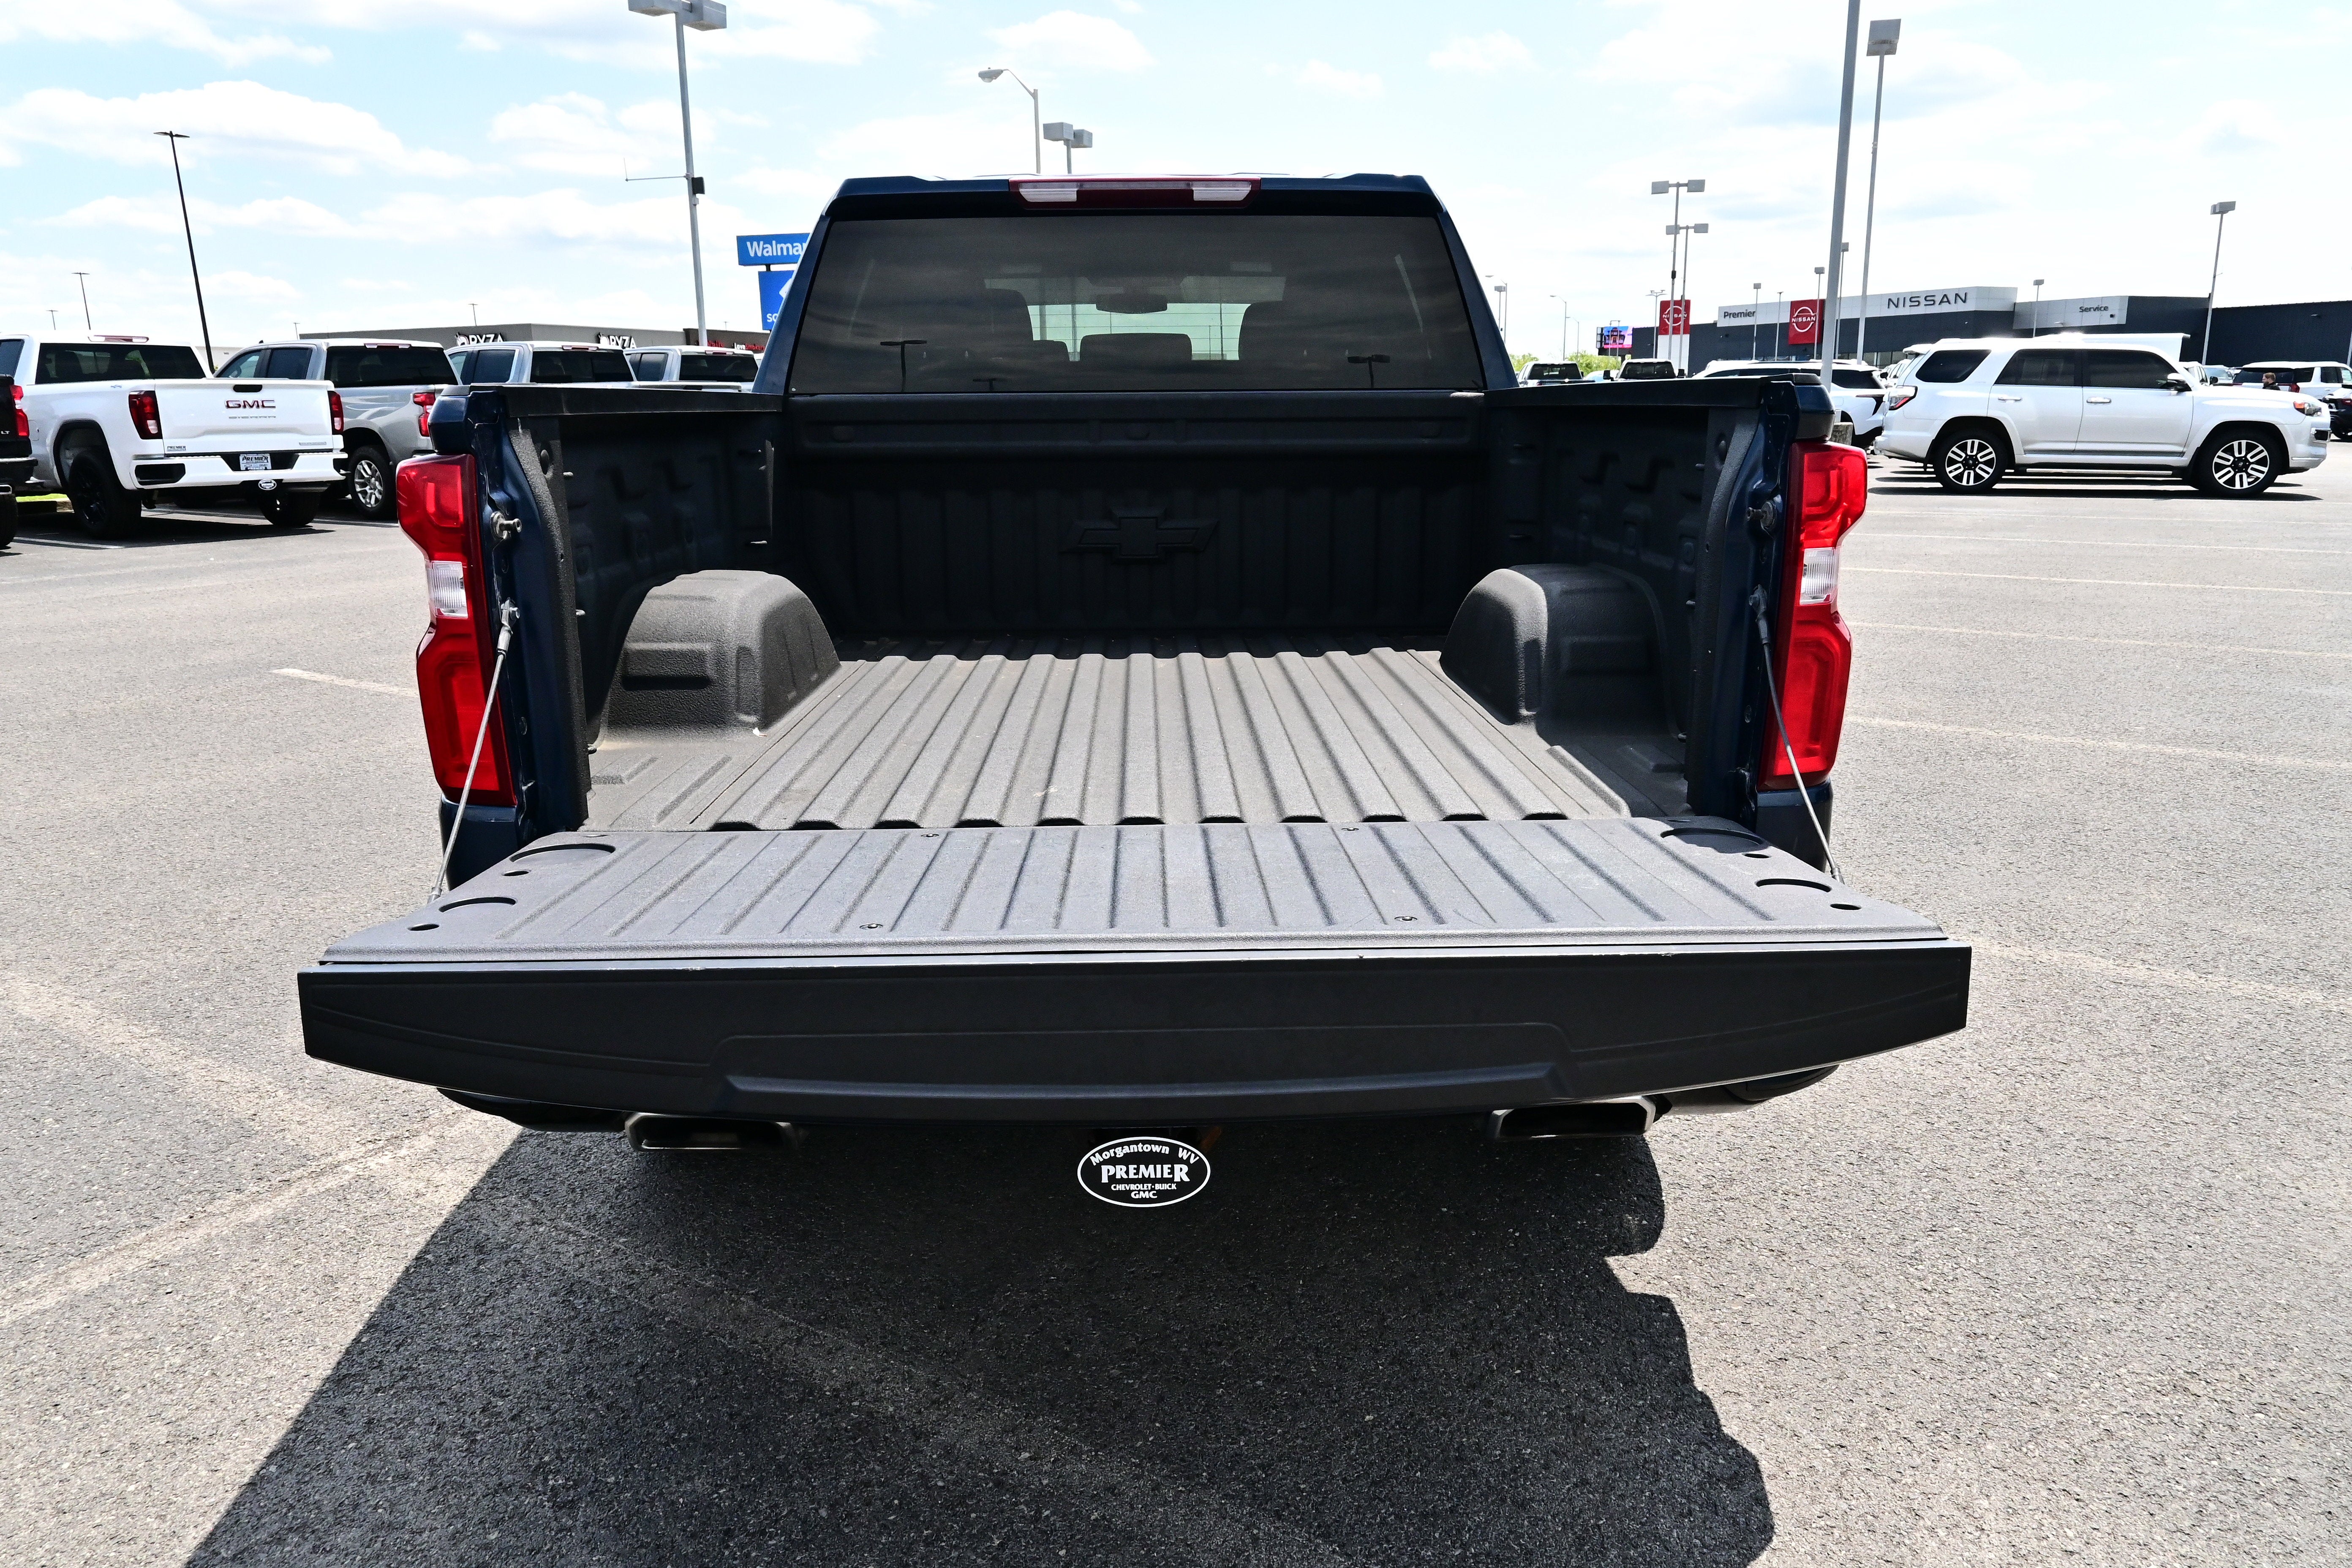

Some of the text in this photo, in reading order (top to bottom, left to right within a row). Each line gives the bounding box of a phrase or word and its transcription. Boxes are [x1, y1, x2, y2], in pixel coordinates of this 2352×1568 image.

[1888, 292, 1968, 308] NISSAN
[1723, 309, 1756, 318] Premier
[225, 400, 276, 408] GMC
[1090, 1143, 1200, 1166] Morgantown WV
[1101, 1164, 1190, 1183] PREMIER
[1131, 1191, 1157, 1199] GMC
